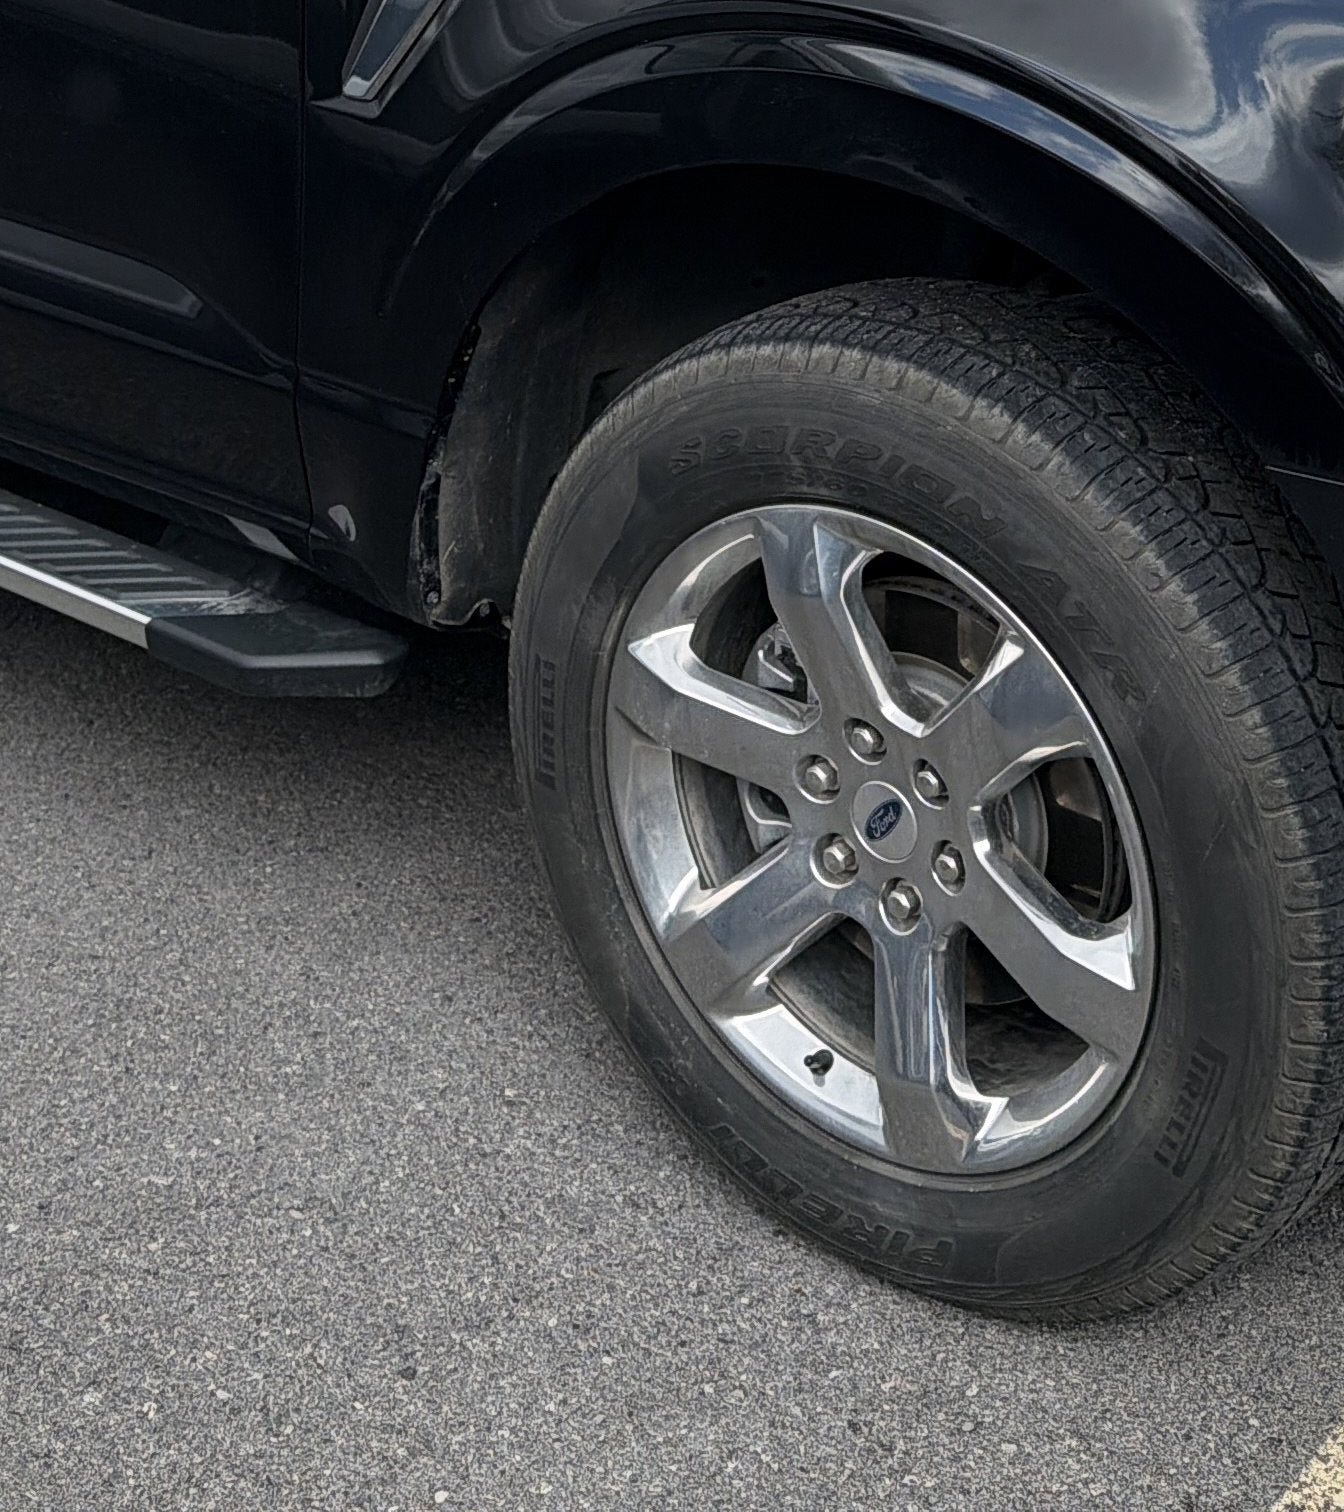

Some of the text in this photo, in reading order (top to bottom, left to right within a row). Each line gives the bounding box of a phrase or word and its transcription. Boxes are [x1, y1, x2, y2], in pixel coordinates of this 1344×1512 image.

[670, 424, 1008, 542] SCORPION
[870, 806, 897, 838] Ford
[704, 1123, 954, 1272] PIRELLI
